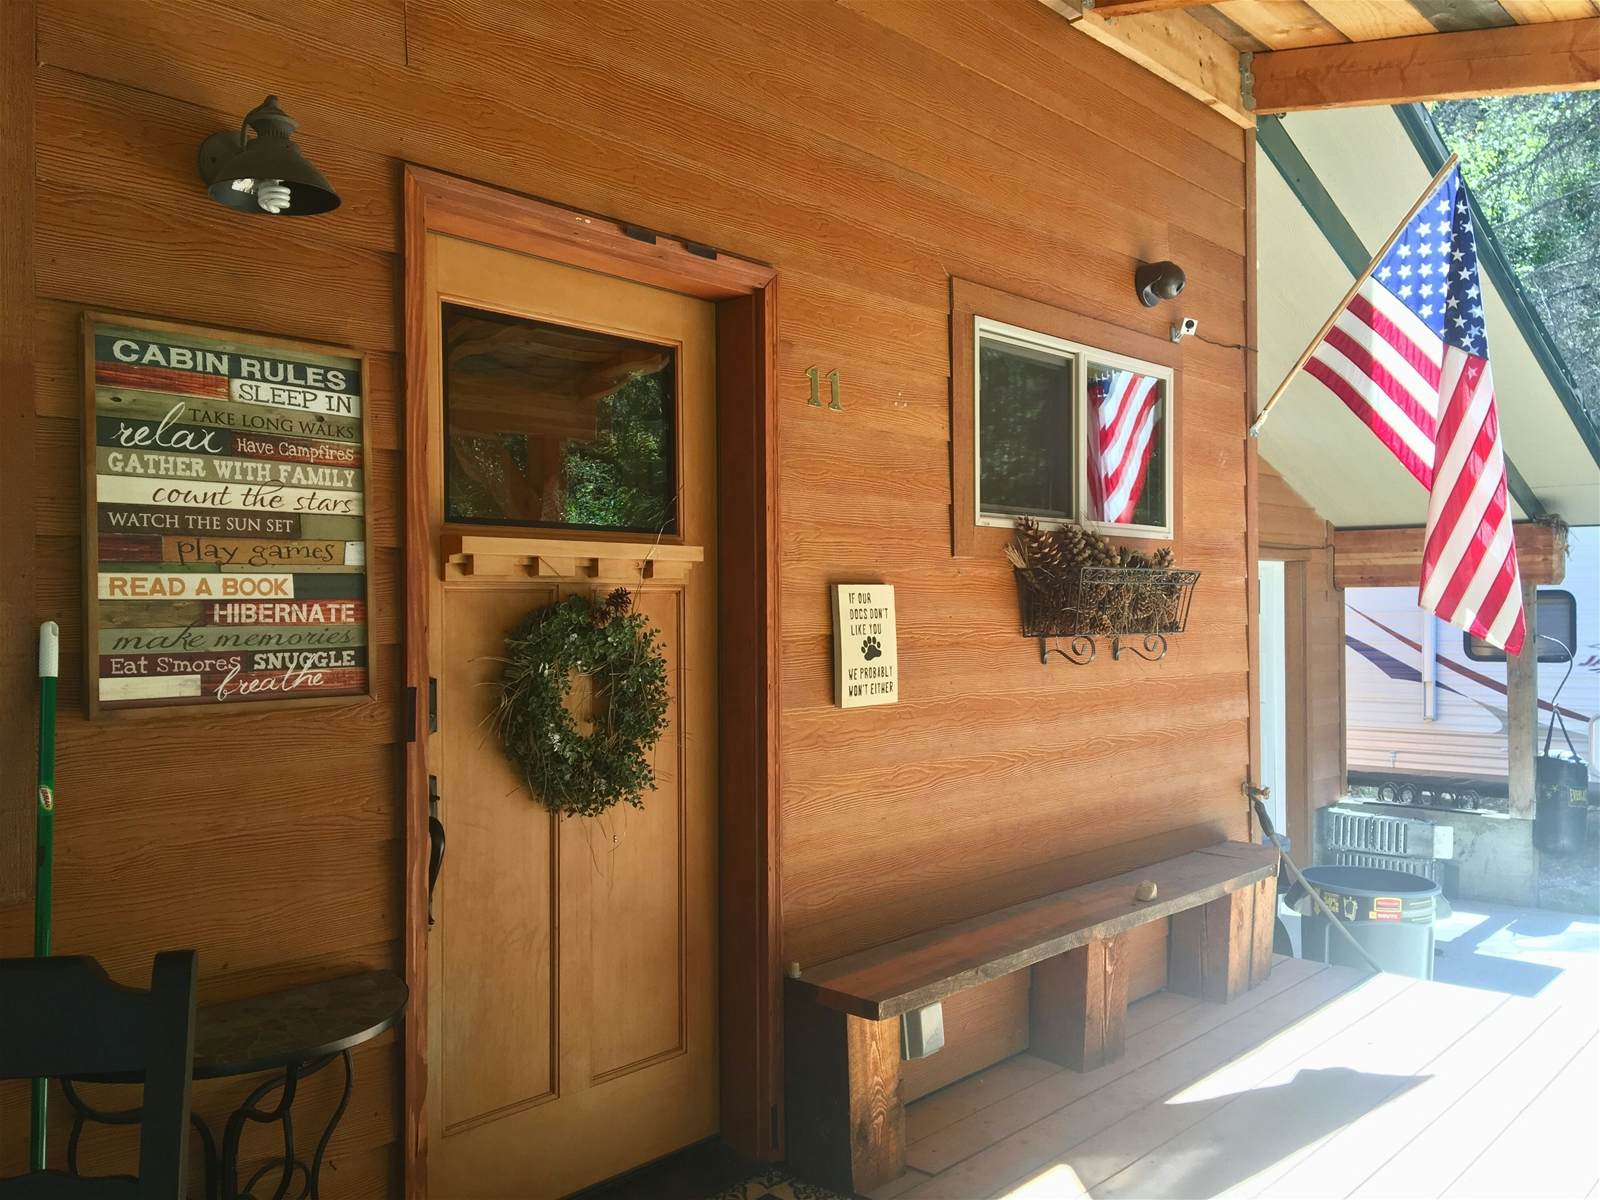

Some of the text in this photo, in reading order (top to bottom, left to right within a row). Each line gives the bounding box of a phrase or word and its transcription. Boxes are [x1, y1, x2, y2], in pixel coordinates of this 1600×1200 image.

[112, 340, 347, 391] CABIN RULES
[239, 384, 352, 414] SLEEP IN
[805, 364, 843, 411] 11
[112, 402, 223, 453] relax
[188, 408, 354, 439] TAKE LONG WALKS
[236, 438, 354, 463] Have Campfires
[107, 452, 355, 488] GATHER WITH FAMILY
[152, 480, 352, 514] count the stars
[108, 512, 294, 533] WATCH THE SUN SET
[176, 538, 335, 566] play games
[108, 577, 289, 596] READ A BOOK
[849, 592, 871, 604] IF OUR
[214, 603, 355, 623] HIBERNATE
[870, 607, 888, 619] DON'T
[111, 620, 354, 650] make memories
[851, 623, 882, 635] LIKE YOU
[110, 655, 241, 674] Eat S'mores
[253, 650, 355, 670] SNUGGLE
[213, 653, 325, 701] breathe
[849, 666, 892, 680] WE PROBABLY
[849, 684, 868, 696] WON'T
